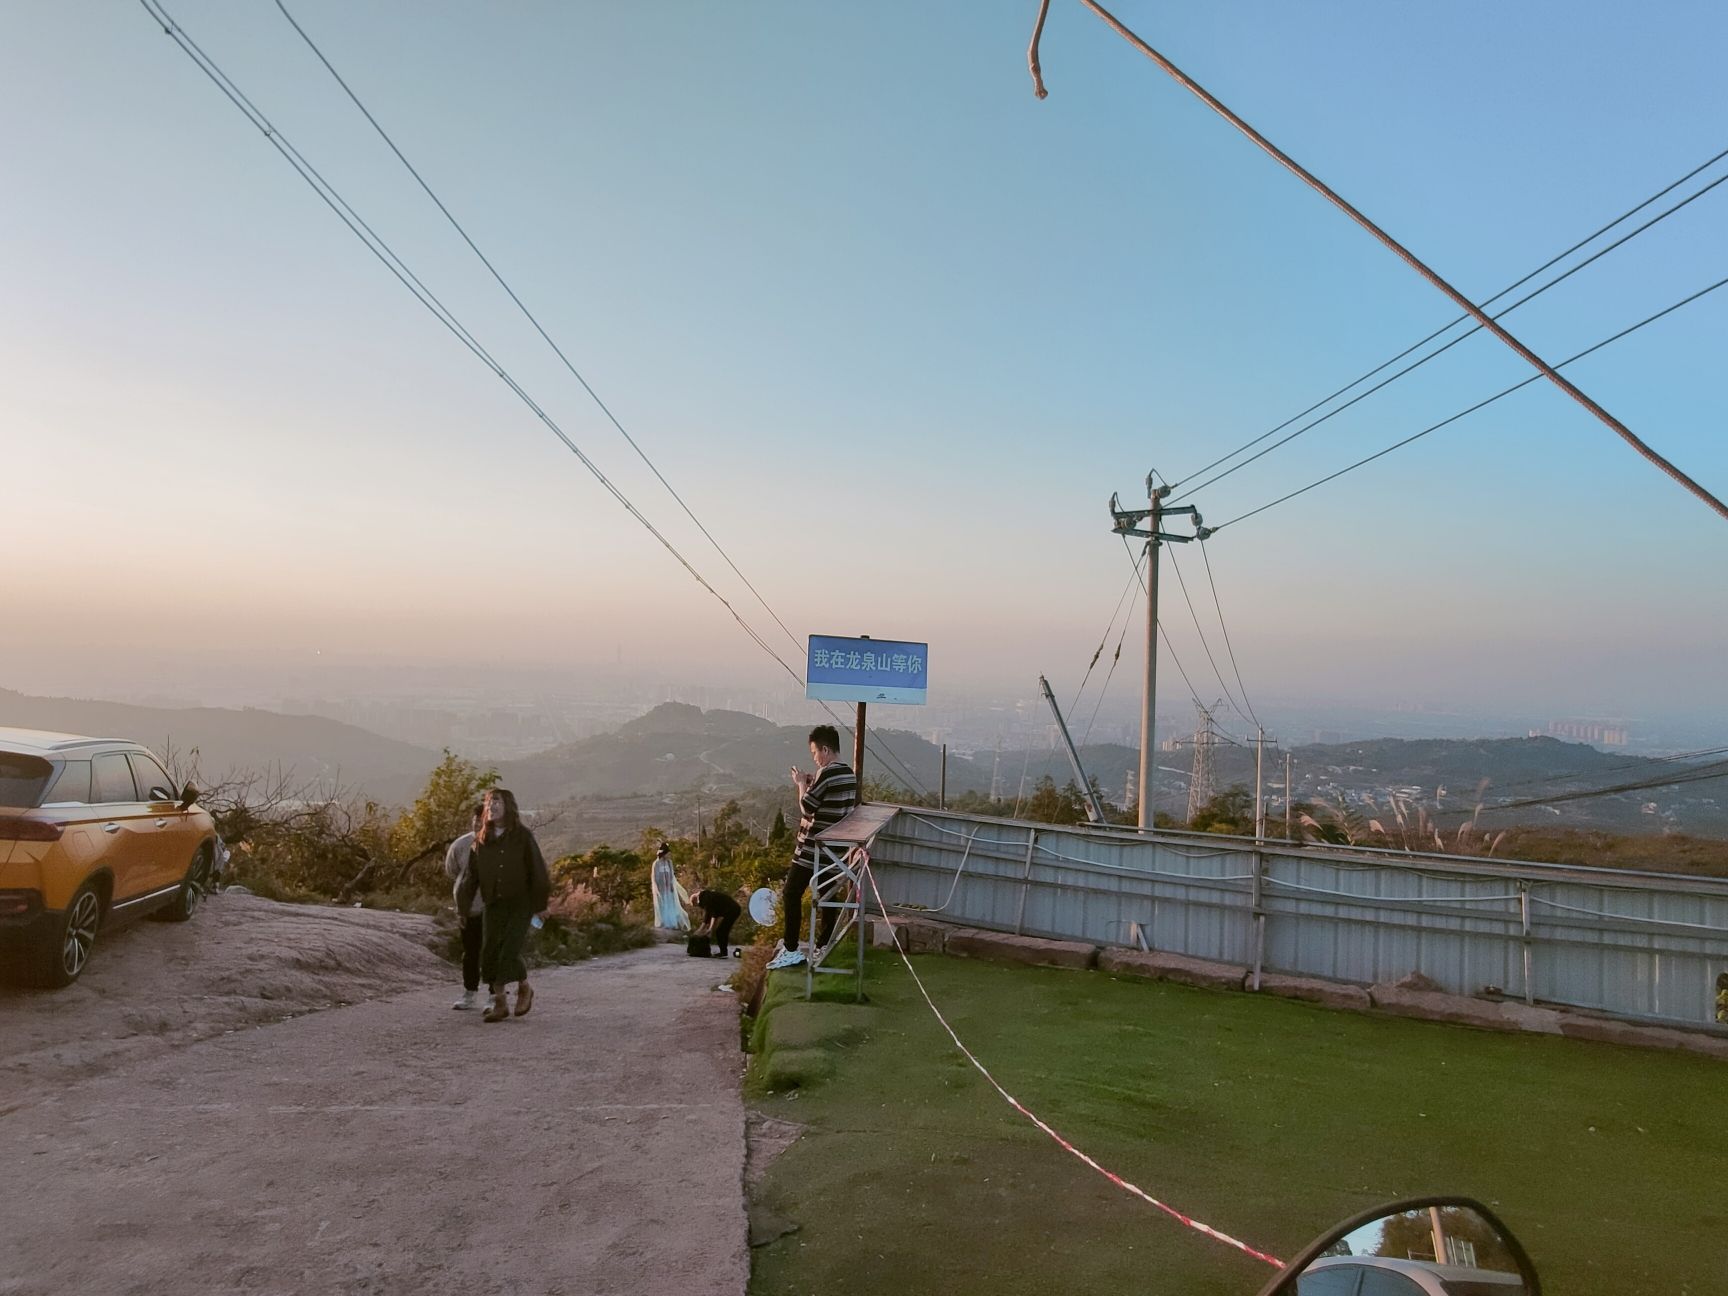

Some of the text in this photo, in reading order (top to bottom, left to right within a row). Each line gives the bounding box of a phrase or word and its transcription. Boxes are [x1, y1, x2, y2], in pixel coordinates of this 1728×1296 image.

[814, 649, 922, 673] 我在龙泉山等你
